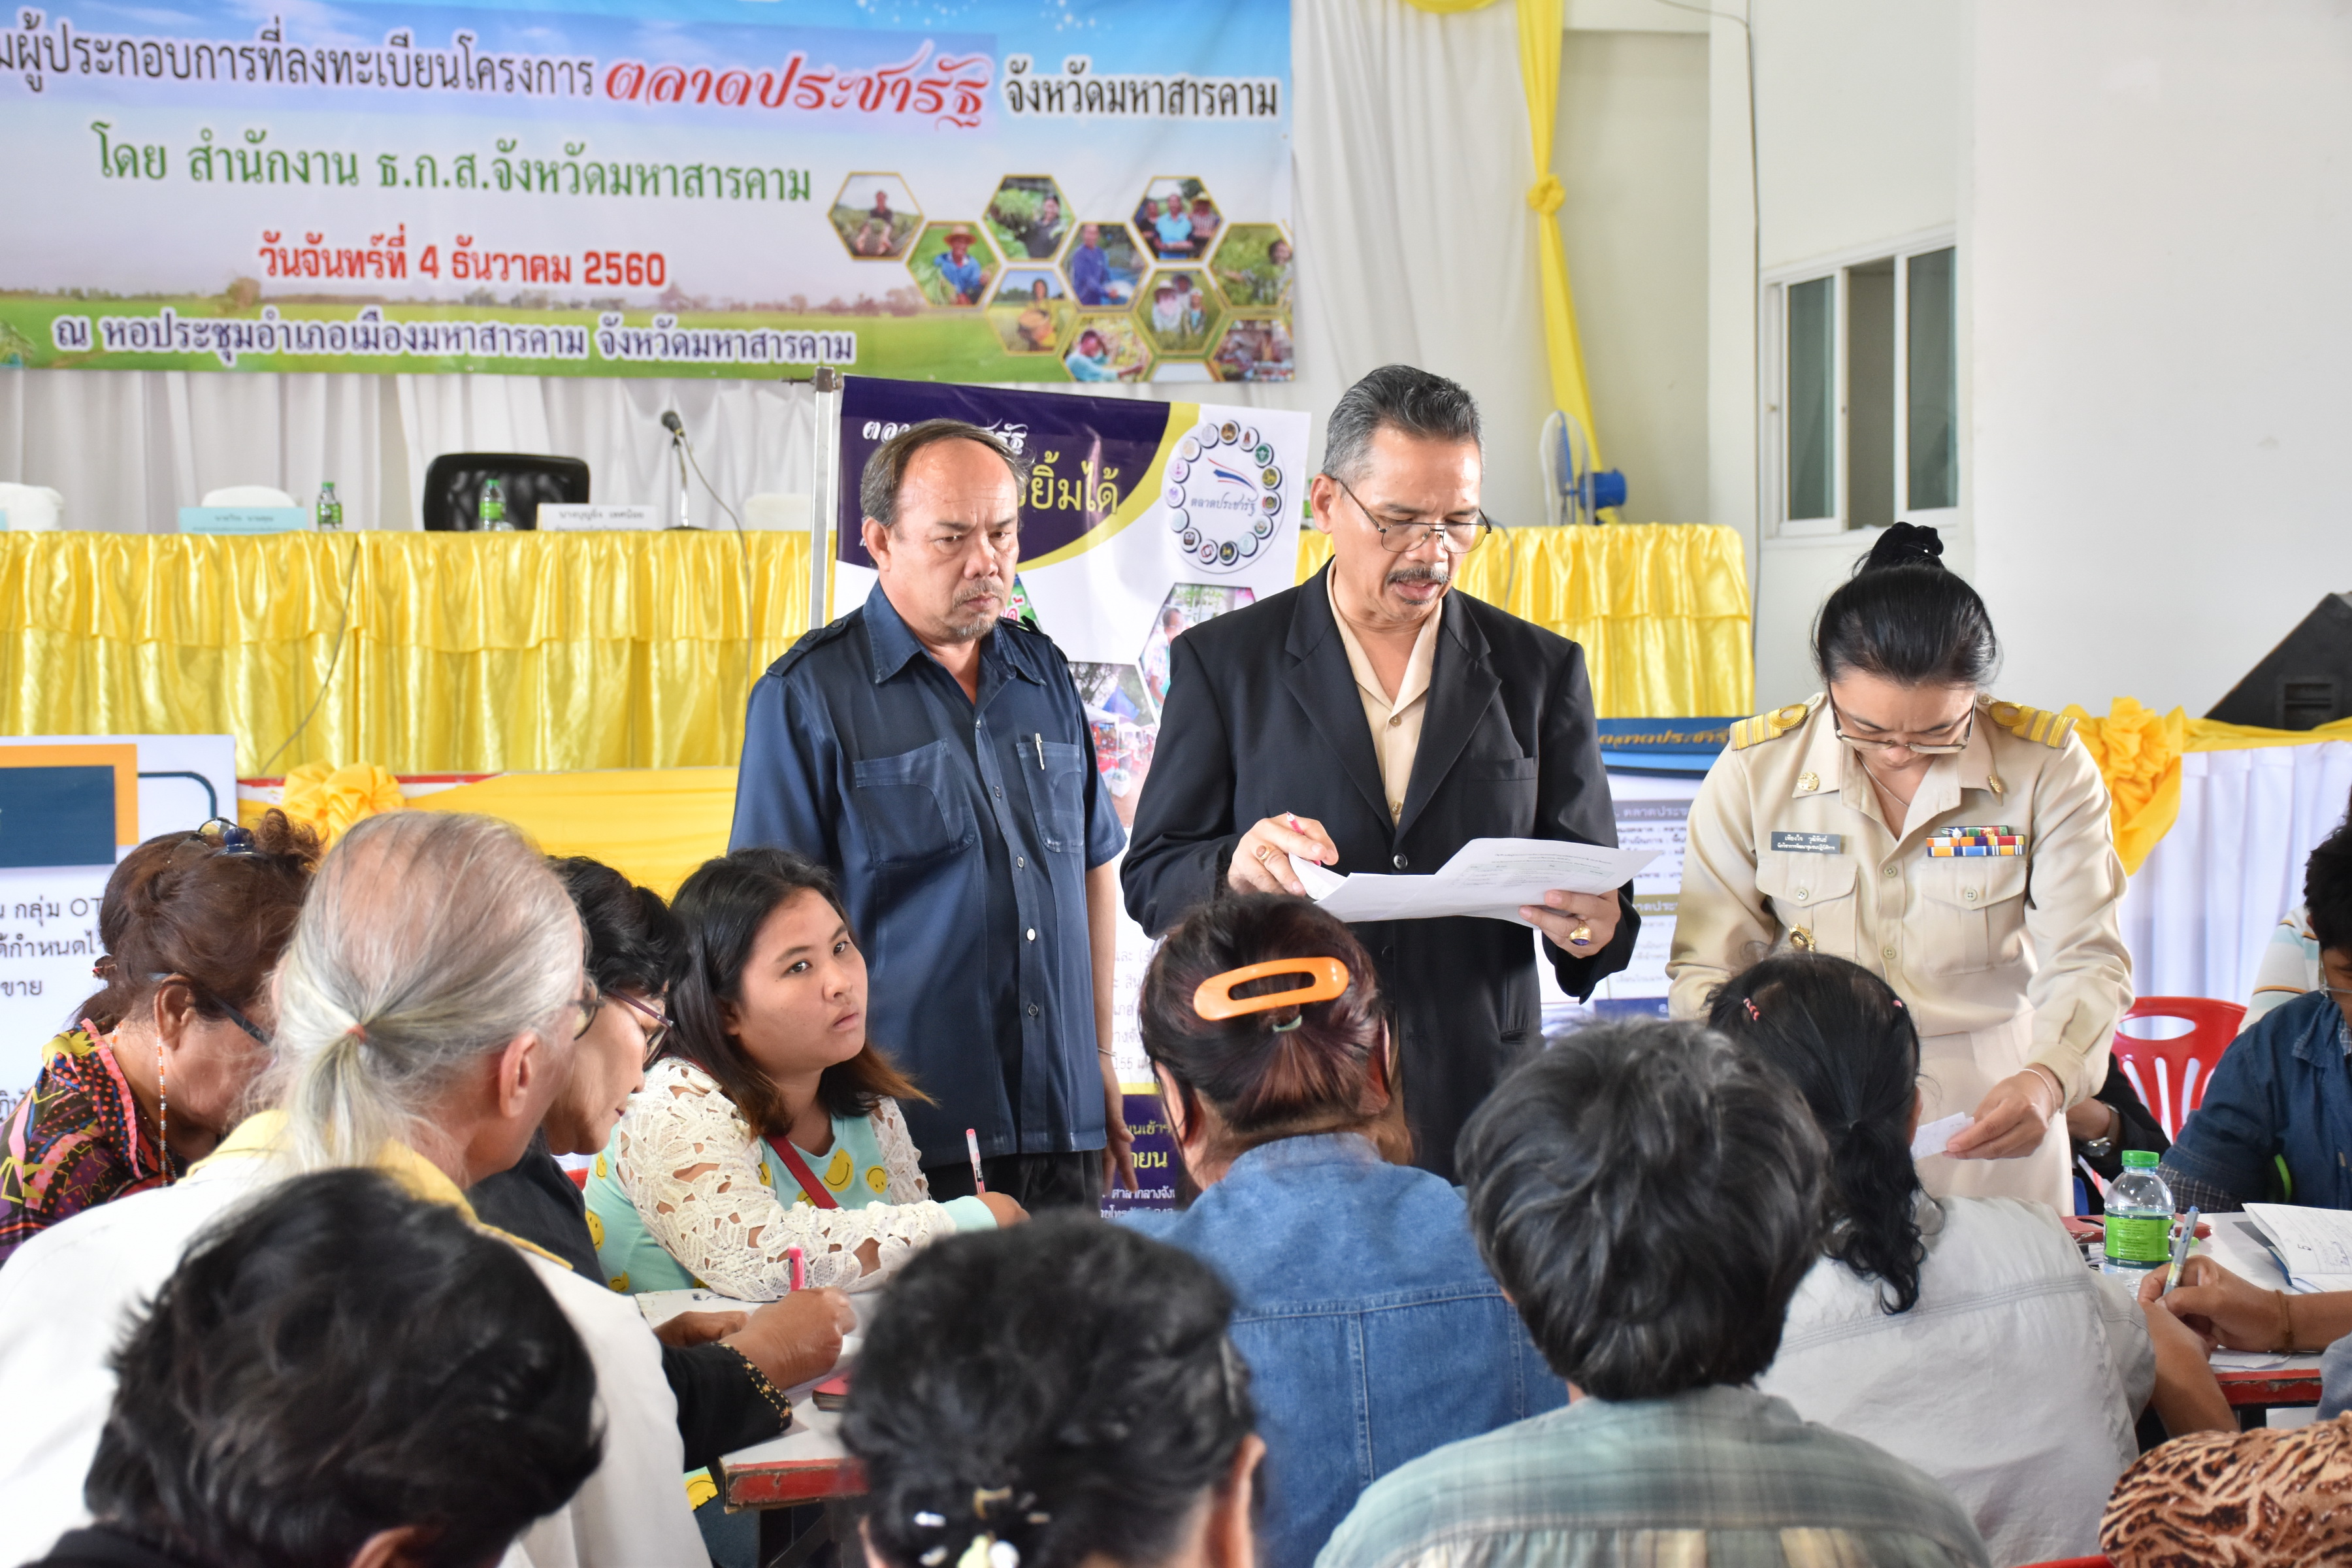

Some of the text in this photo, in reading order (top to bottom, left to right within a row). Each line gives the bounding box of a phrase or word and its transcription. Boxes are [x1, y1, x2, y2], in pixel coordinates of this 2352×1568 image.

[605, 42, 990, 129] ตลาดประชารัฐ
[1007, 59, 1277, 116] จังหวัดมหาสารคาม
[91, 122, 811, 201] โดย สำนักงาน ธ.ก.ส.จังหวัดมหาสารคาม
[259, 225, 664, 285] วันจันทร์ที่ 4 ธันวาคม 2560
[55, 309, 852, 363] ณ หอประชุมอำเภอเมืองมหาสารคาม จังหวัดมหาสารคาม
[1018, 451, 1119, 514] ยิ้มได้
[15, 895, 59, 927] กลุ่ม
[71, 898, 103, 916] OT
